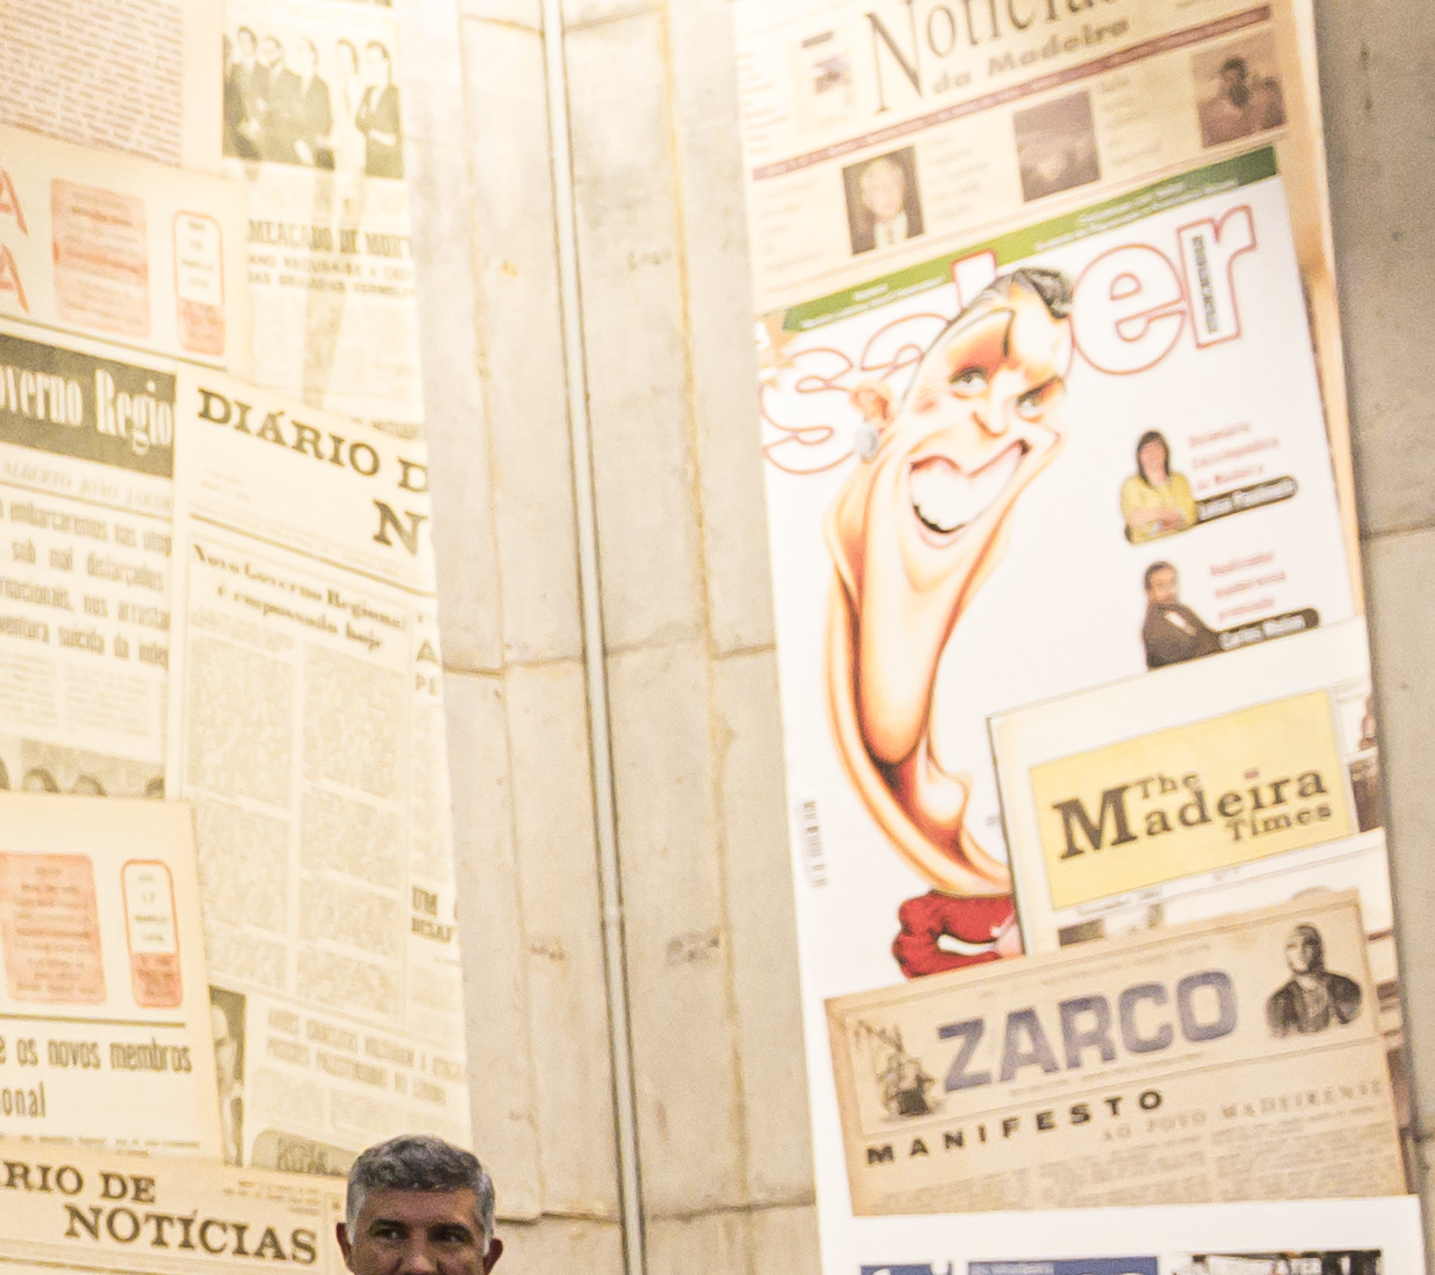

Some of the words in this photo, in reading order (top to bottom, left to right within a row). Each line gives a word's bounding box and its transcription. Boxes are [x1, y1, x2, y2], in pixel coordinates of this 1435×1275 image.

[197, 386, 381, 478] DIÁRIO
[1051, 767, 1330, 861] Madeira
[1135, 770, 1199, 801] The
[1224, 802, 1334, 844] Times
[17, 1039, 38, 1066] os
[48, 1038, 101, 1070] novos
[110, 1036, 192, 1074] membros
[936, 969, 1239, 1095] ZARCO
[865, 1089, 1164, 1167] MANIFESTO
[100, 1173, 157, 1204] DE
[65, 1204, 318, 1265] NOTÍCIAS
